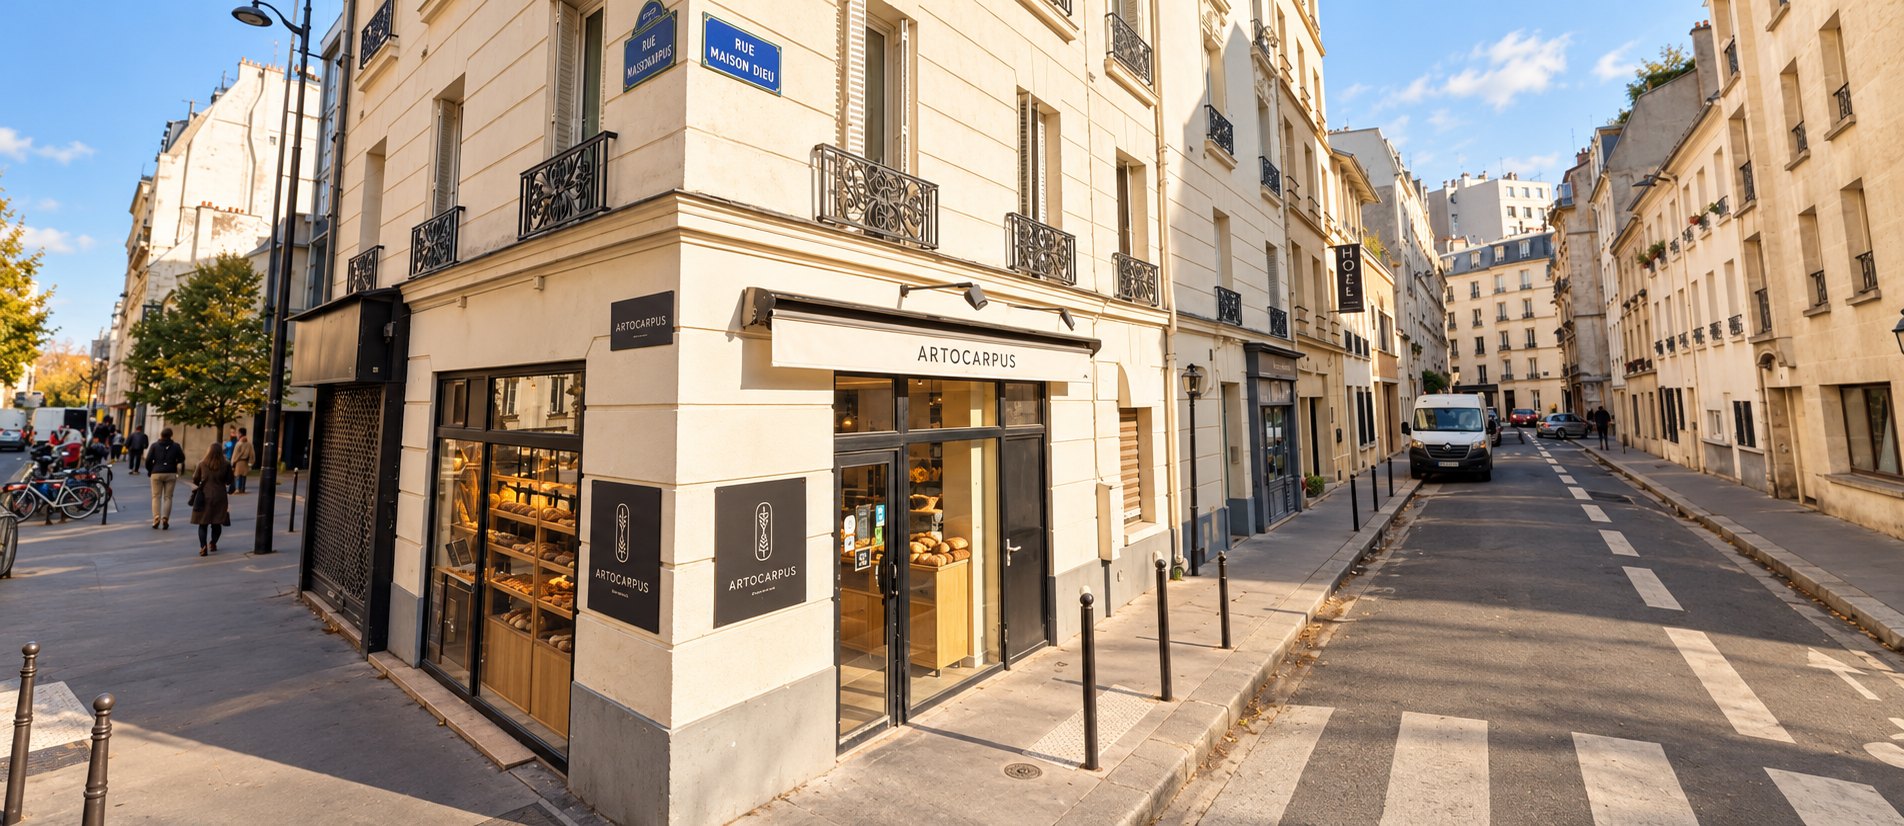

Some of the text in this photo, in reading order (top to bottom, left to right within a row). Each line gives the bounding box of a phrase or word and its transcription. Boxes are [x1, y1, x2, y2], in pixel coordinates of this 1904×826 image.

[642, 34, 656, 52] RUE
[735, 37, 755, 57] RUE
[710, 47, 774, 83] MAISON DIEU
[615, 315, 667, 333] ARTOCARPUS
[917, 345, 1016, 369] ARTOCARPUS
[595, 568, 649, 594] ARTOCARPUS
[728, 565, 797, 591] ARTOCARPUS
